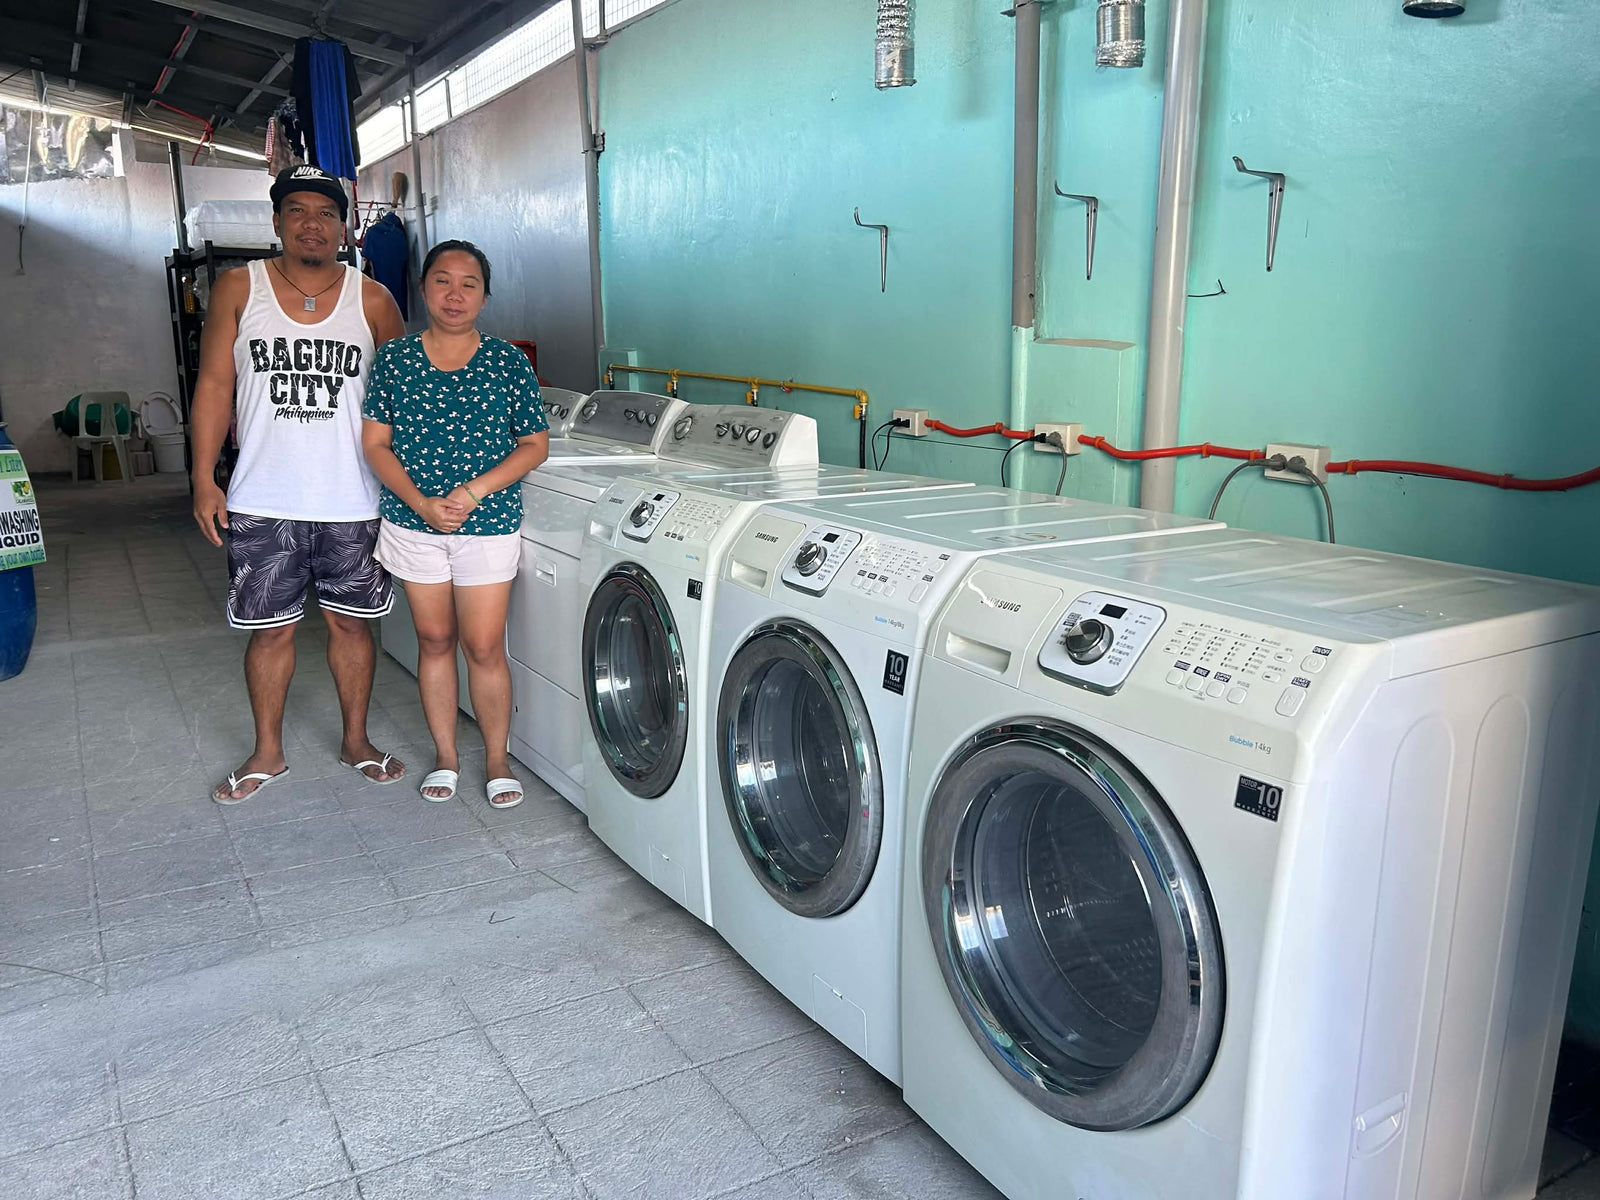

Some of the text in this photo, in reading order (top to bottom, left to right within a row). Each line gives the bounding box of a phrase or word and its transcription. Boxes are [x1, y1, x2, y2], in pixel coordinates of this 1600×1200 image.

[295, 165, 323, 176] NIKE
[249, 337, 362, 378] BAGUIO
[270, 373, 344, 408] CITY
[274, 406, 335, 423] Philippines
[755, 532, 779, 543] SAMSUNG
[890, 654, 904, 676] 10
[889, 673, 901, 683] YEAR
[1229, 735, 1272, 755] Bubble 14kg
[1240, 777, 1259, 789] MOTOR
[1257, 784, 1280, 809] 10
